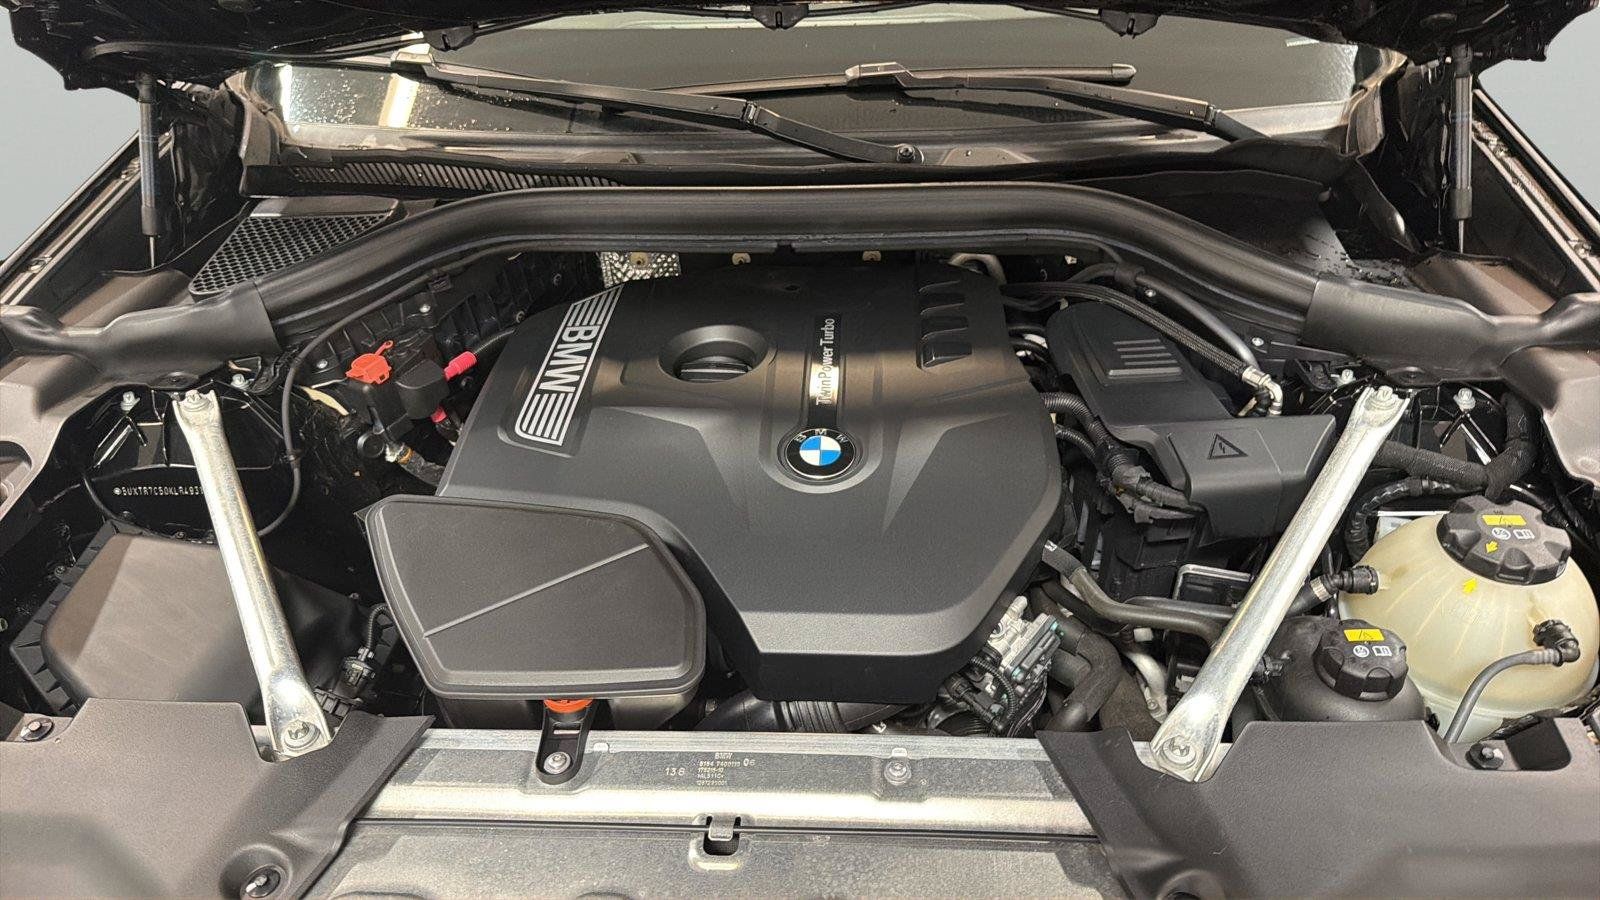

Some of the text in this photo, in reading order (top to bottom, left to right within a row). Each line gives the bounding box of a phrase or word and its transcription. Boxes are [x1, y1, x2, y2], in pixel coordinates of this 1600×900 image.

[538, 325, 601, 393] BMW
[816, 318, 835, 405] TwinPower Turbo
[795, 428, 848, 444] BMW
